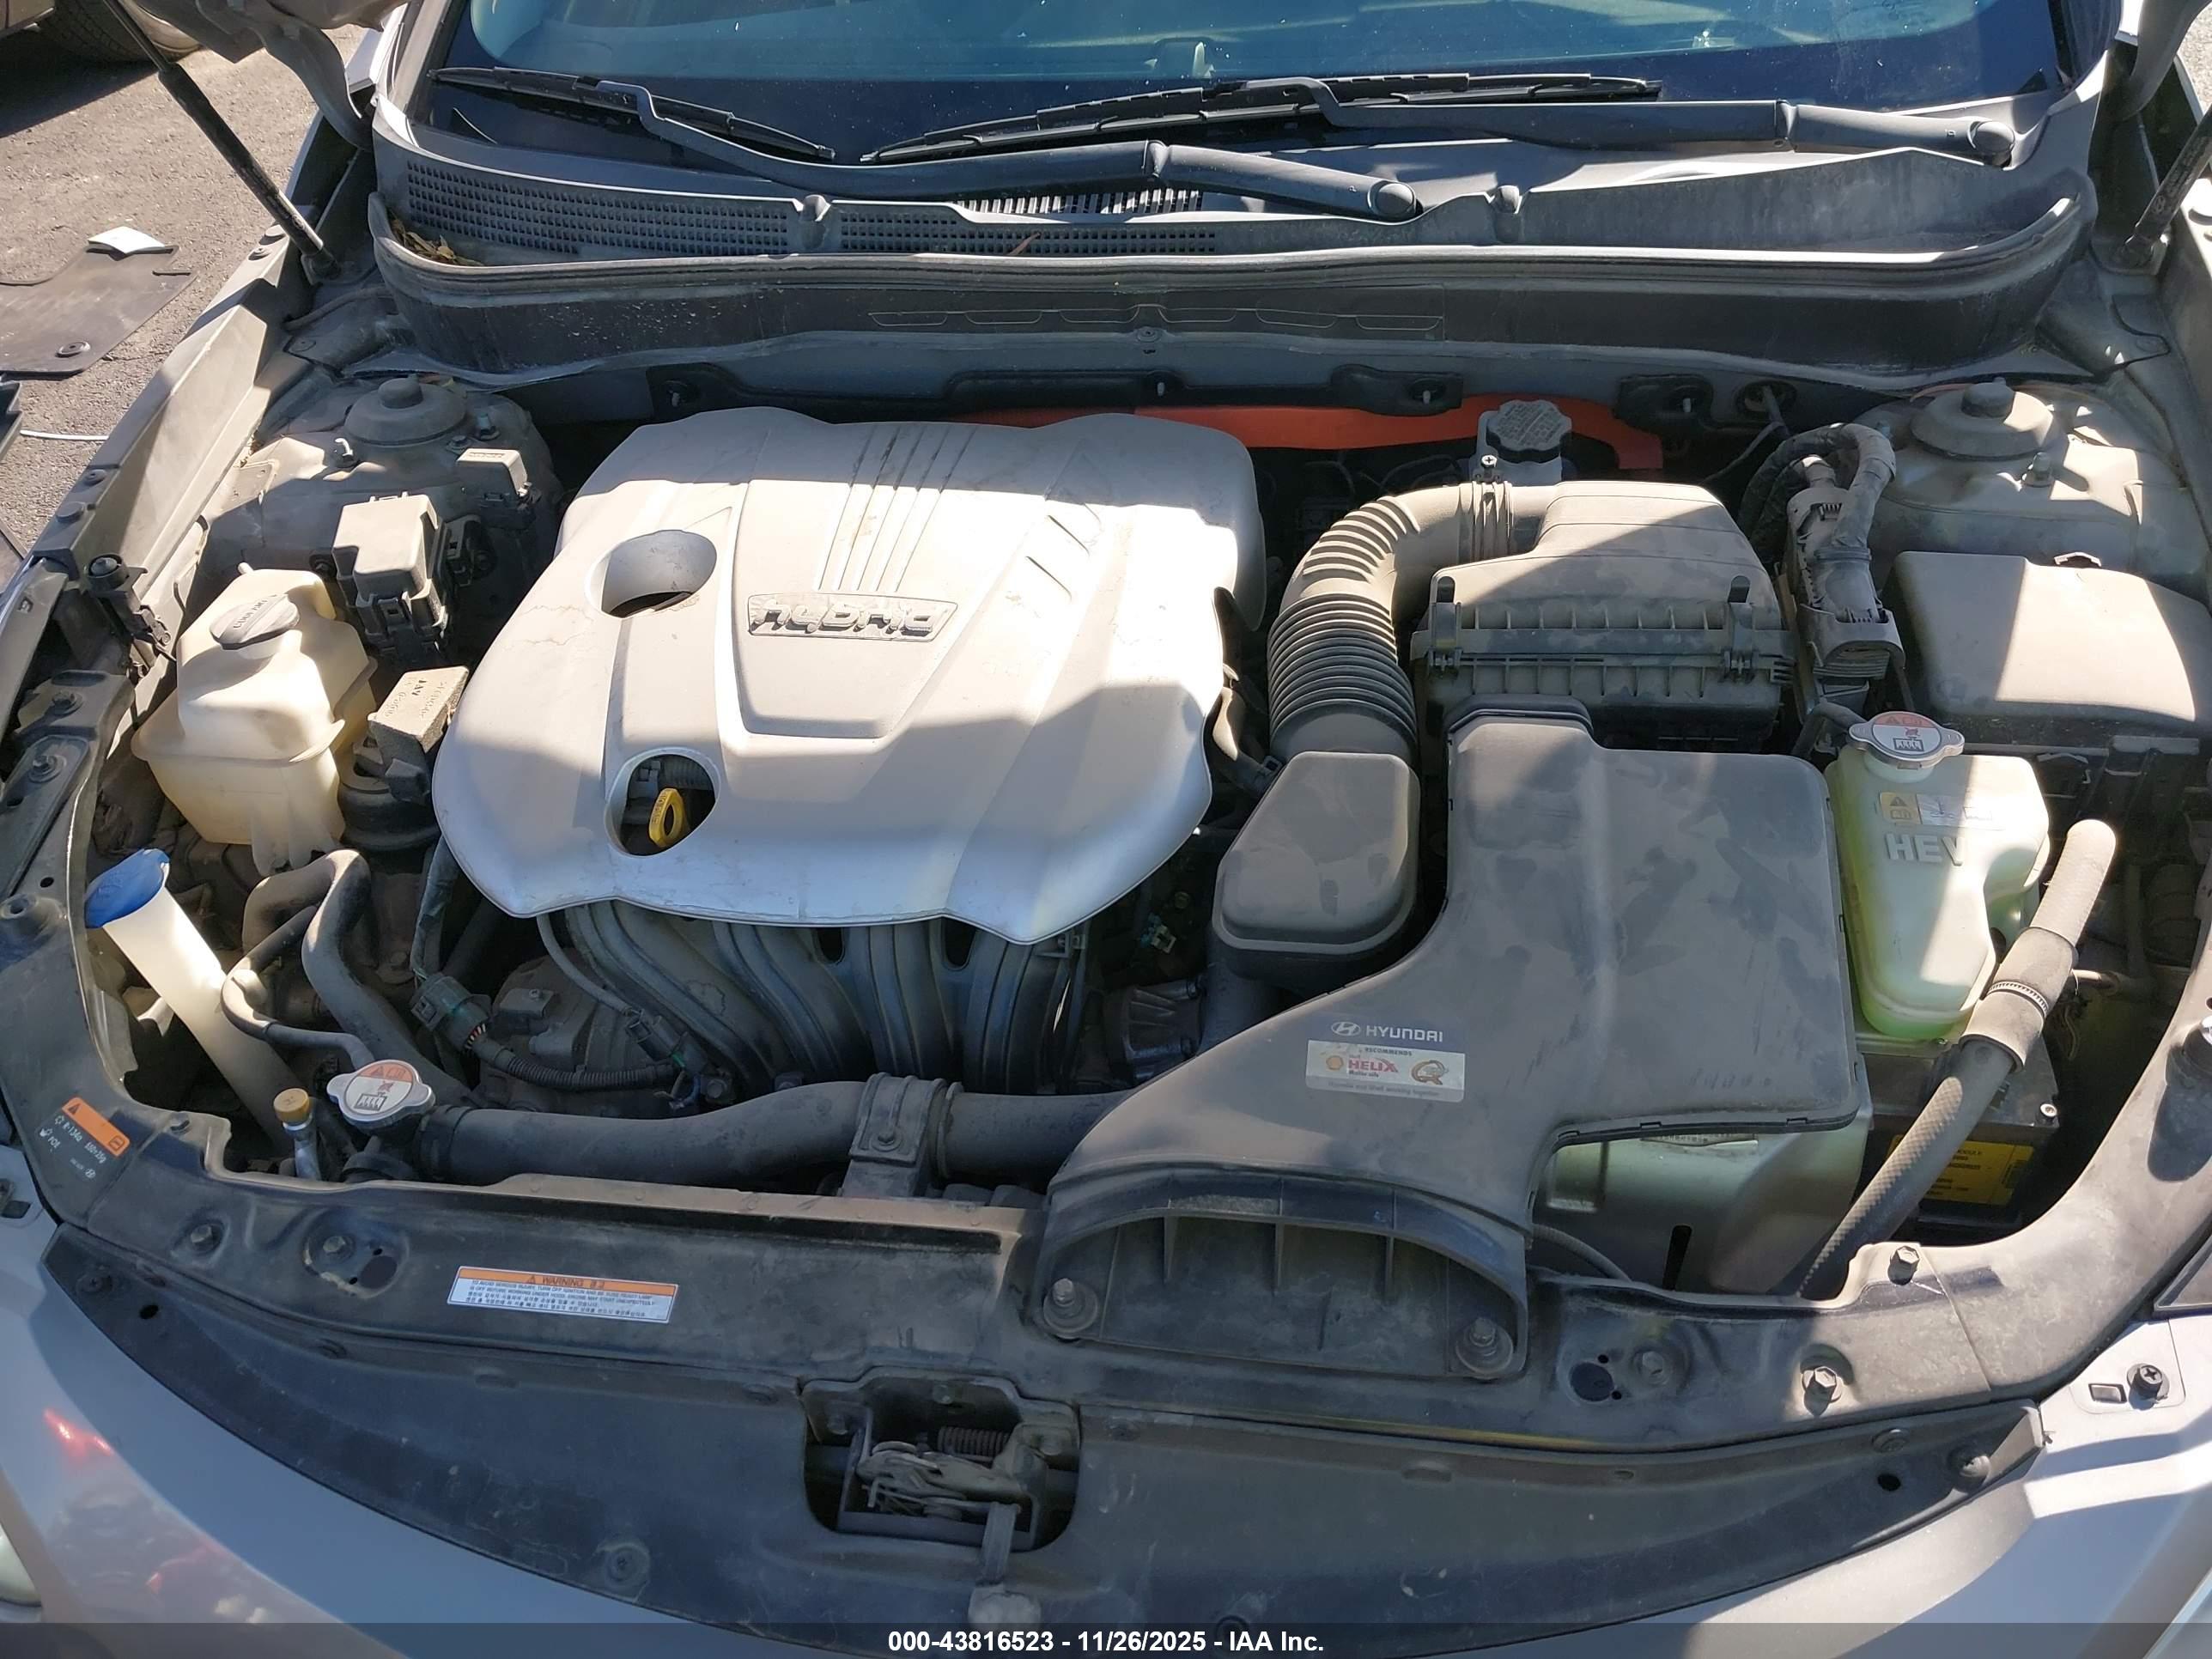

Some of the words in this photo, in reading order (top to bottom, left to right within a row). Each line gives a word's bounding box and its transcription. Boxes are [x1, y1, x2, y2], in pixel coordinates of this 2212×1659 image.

[1884, 832, 1964, 866] HEV
[1365, 1024, 1444, 1043] HYUNDAI
[1364, 1047, 1413, 1057] RECOMMENDS
[1348, 1059, 1399, 1073] HELIX
[542, 1276, 585, 1288] WARNING
